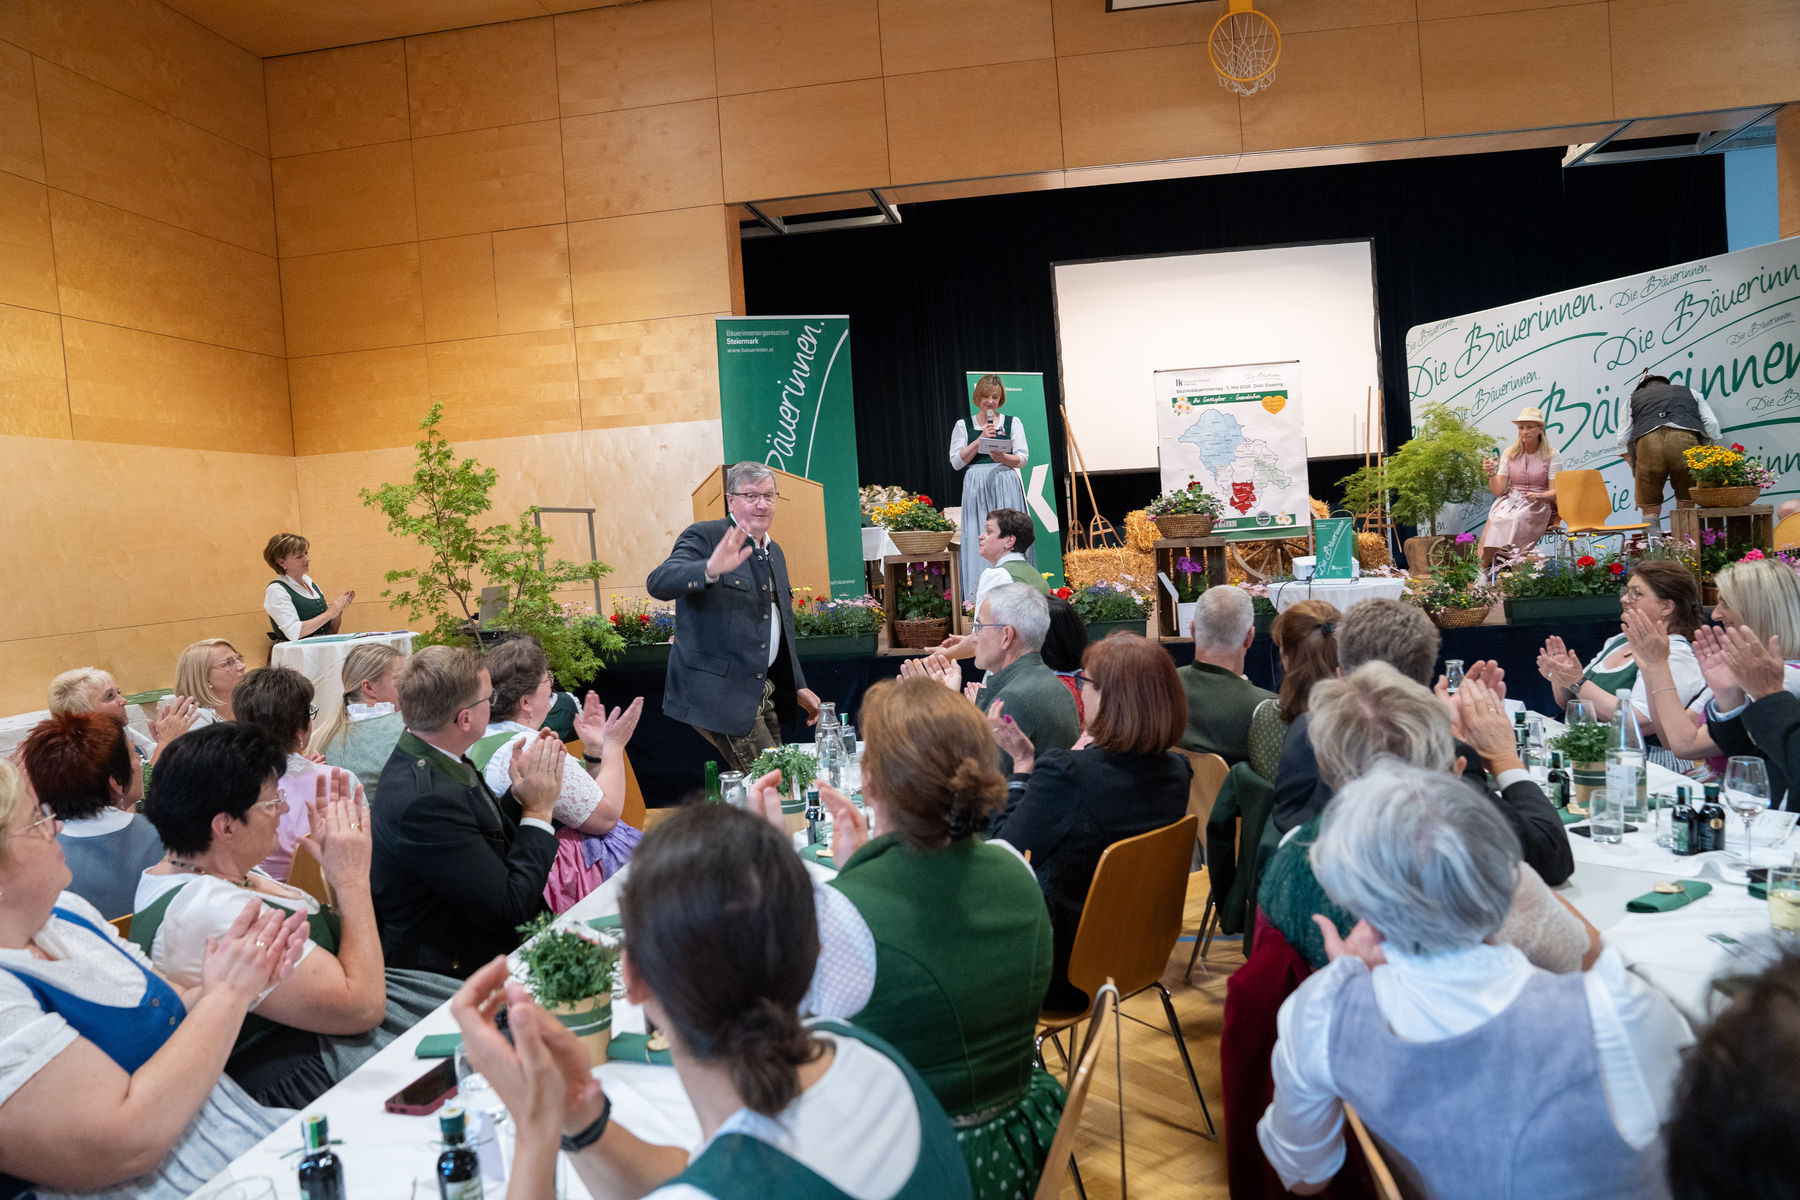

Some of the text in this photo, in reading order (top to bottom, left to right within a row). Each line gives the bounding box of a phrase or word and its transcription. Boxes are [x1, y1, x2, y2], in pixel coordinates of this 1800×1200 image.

[1609, 263, 1711, 308] Die Bäuerinnen.
[726, 337, 759, 345] Steiermark
[1406, 291, 1603, 402] Die Bäuerinnen.
[1593, 327, 1656, 371] Die
[1471, 371, 1541, 418] Bäuerinnen.
[1746, 395, 1775, 411] Die
